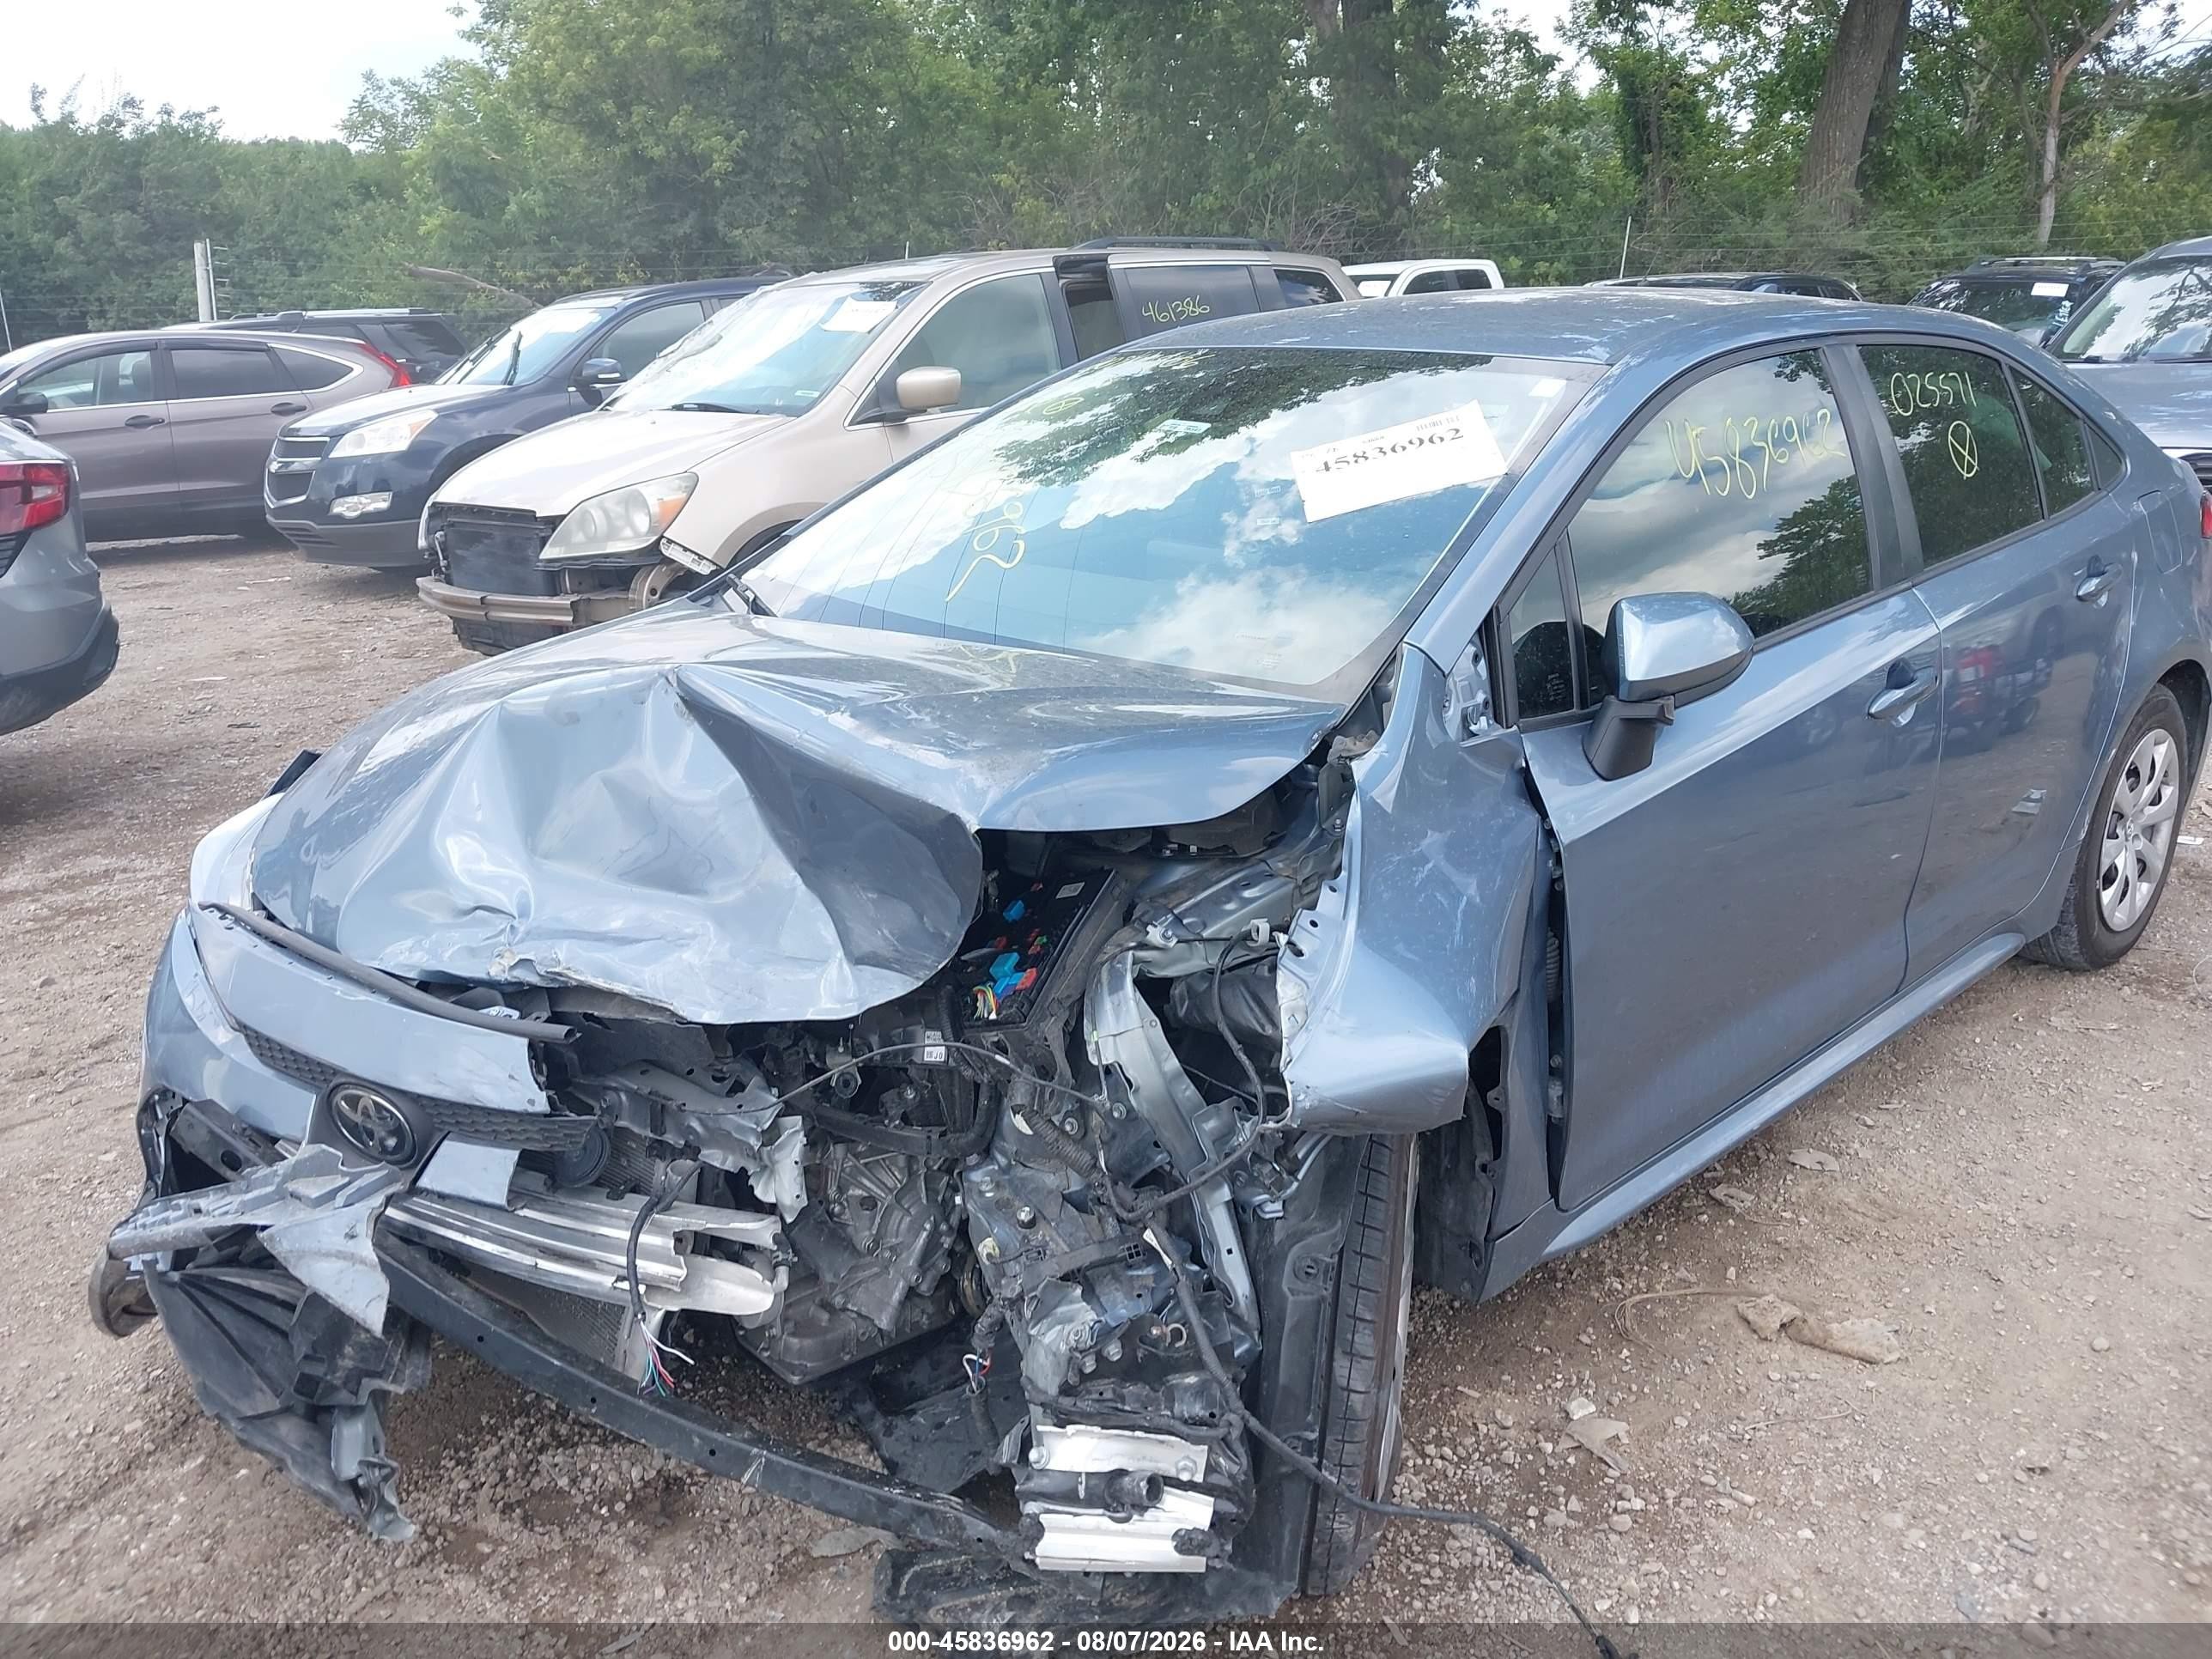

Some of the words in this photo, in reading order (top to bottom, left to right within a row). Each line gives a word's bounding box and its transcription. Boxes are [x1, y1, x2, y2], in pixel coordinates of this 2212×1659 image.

[1142, 295, 1210, 323] 461386
[1890, 371, 1977, 416] 025571
[1316, 427, 1464, 472] 45836962
[1664, 407, 1846, 500] 45836962
